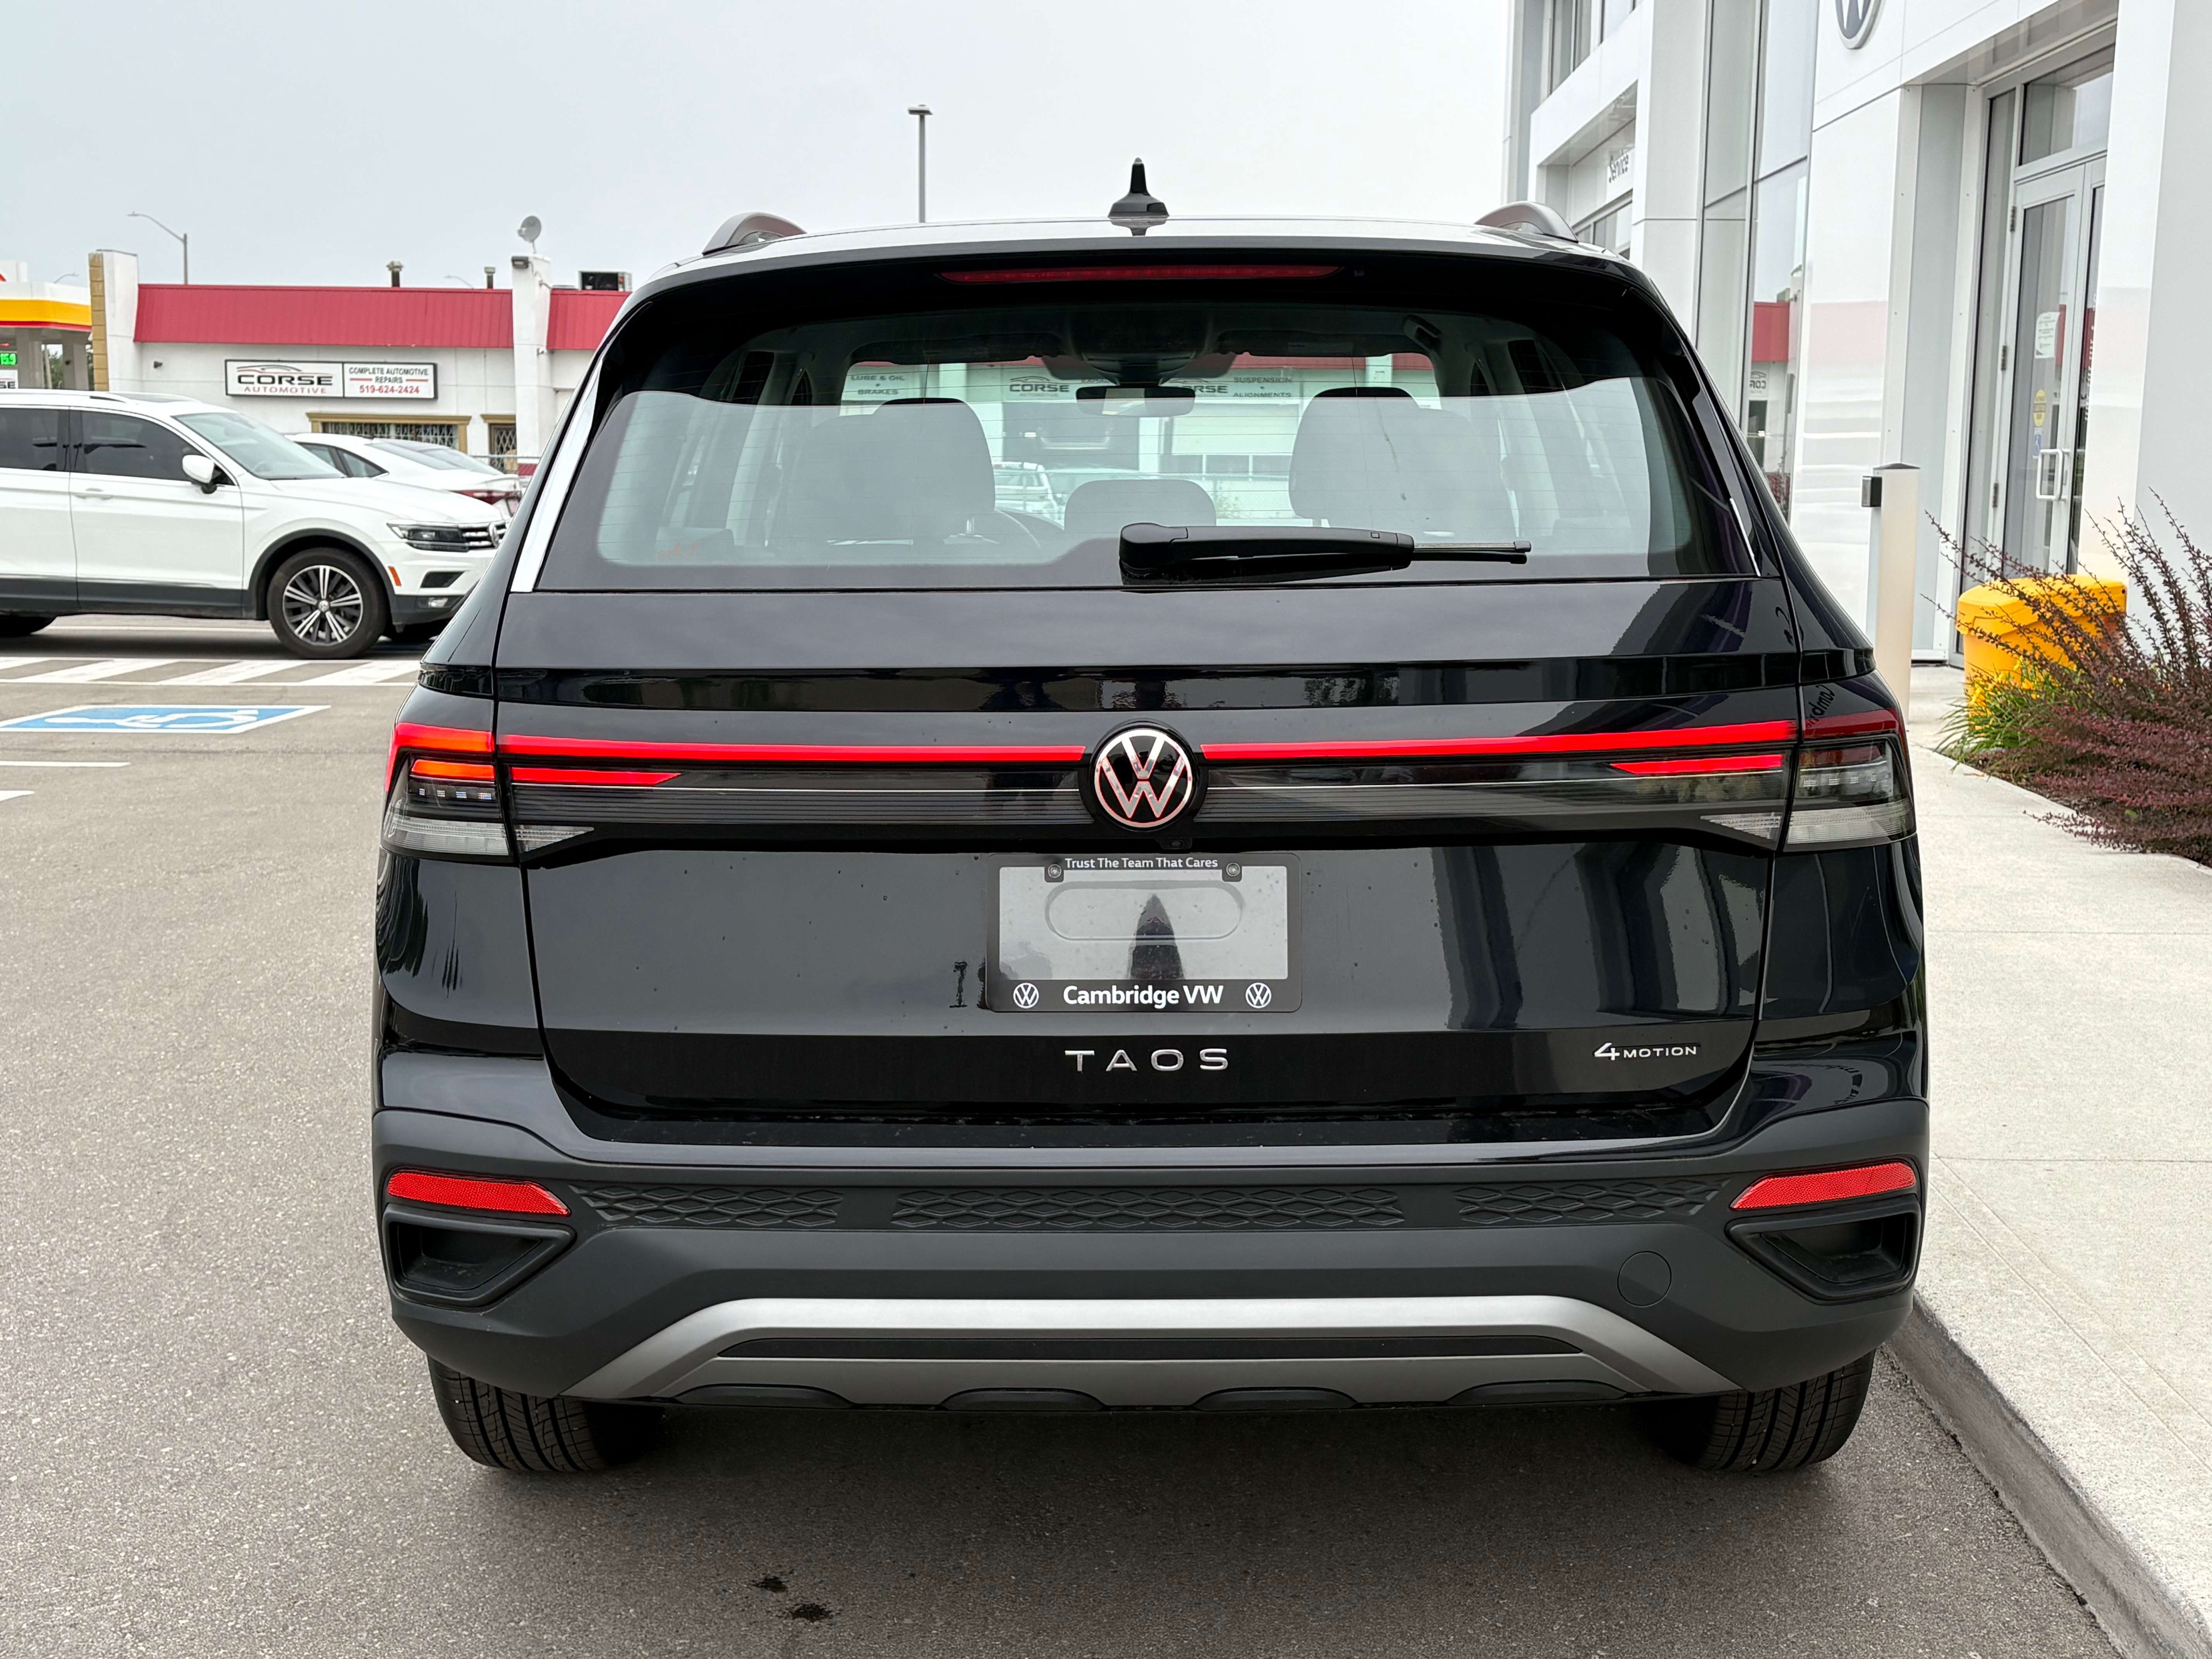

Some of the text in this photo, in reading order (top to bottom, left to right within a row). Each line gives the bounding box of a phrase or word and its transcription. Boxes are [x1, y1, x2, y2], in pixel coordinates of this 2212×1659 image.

[237, 374, 333, 386] CORSE
[359, 385, 420, 394] 519-624-2424
[1065, 857, 1218, 868] Trust The Team That Cares
[1063, 985, 1223, 1008] Cambridge VW
[1065, 1048, 1228, 1072] TAOS
